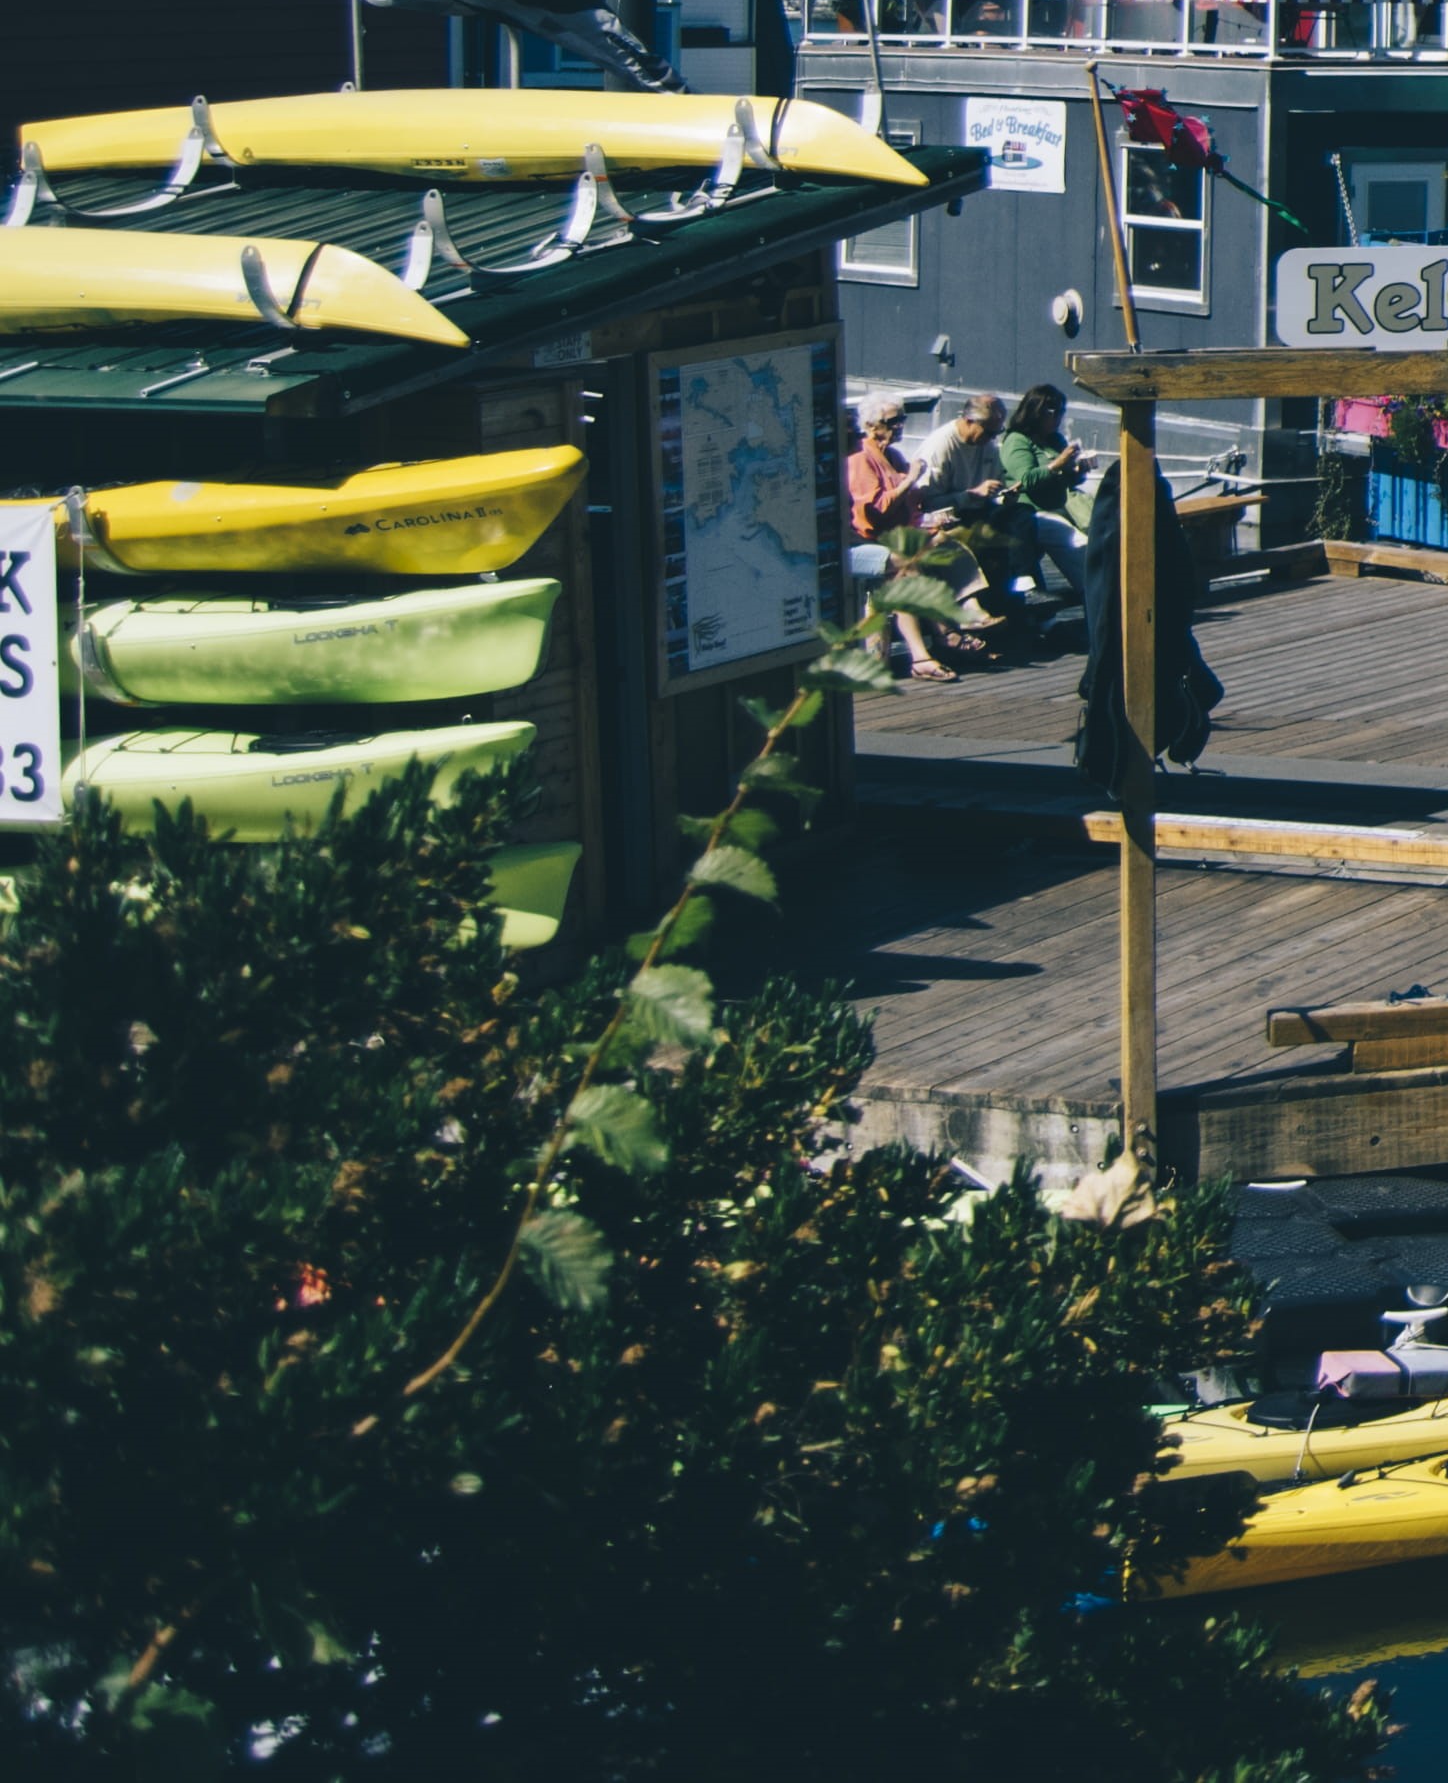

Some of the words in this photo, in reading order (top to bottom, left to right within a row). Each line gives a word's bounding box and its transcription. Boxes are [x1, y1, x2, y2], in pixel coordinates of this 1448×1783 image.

[970, 117, 994, 142] Bed
[1005, 115, 1062, 148] Breakfast
[375, 510, 473, 531] CAROLINA
